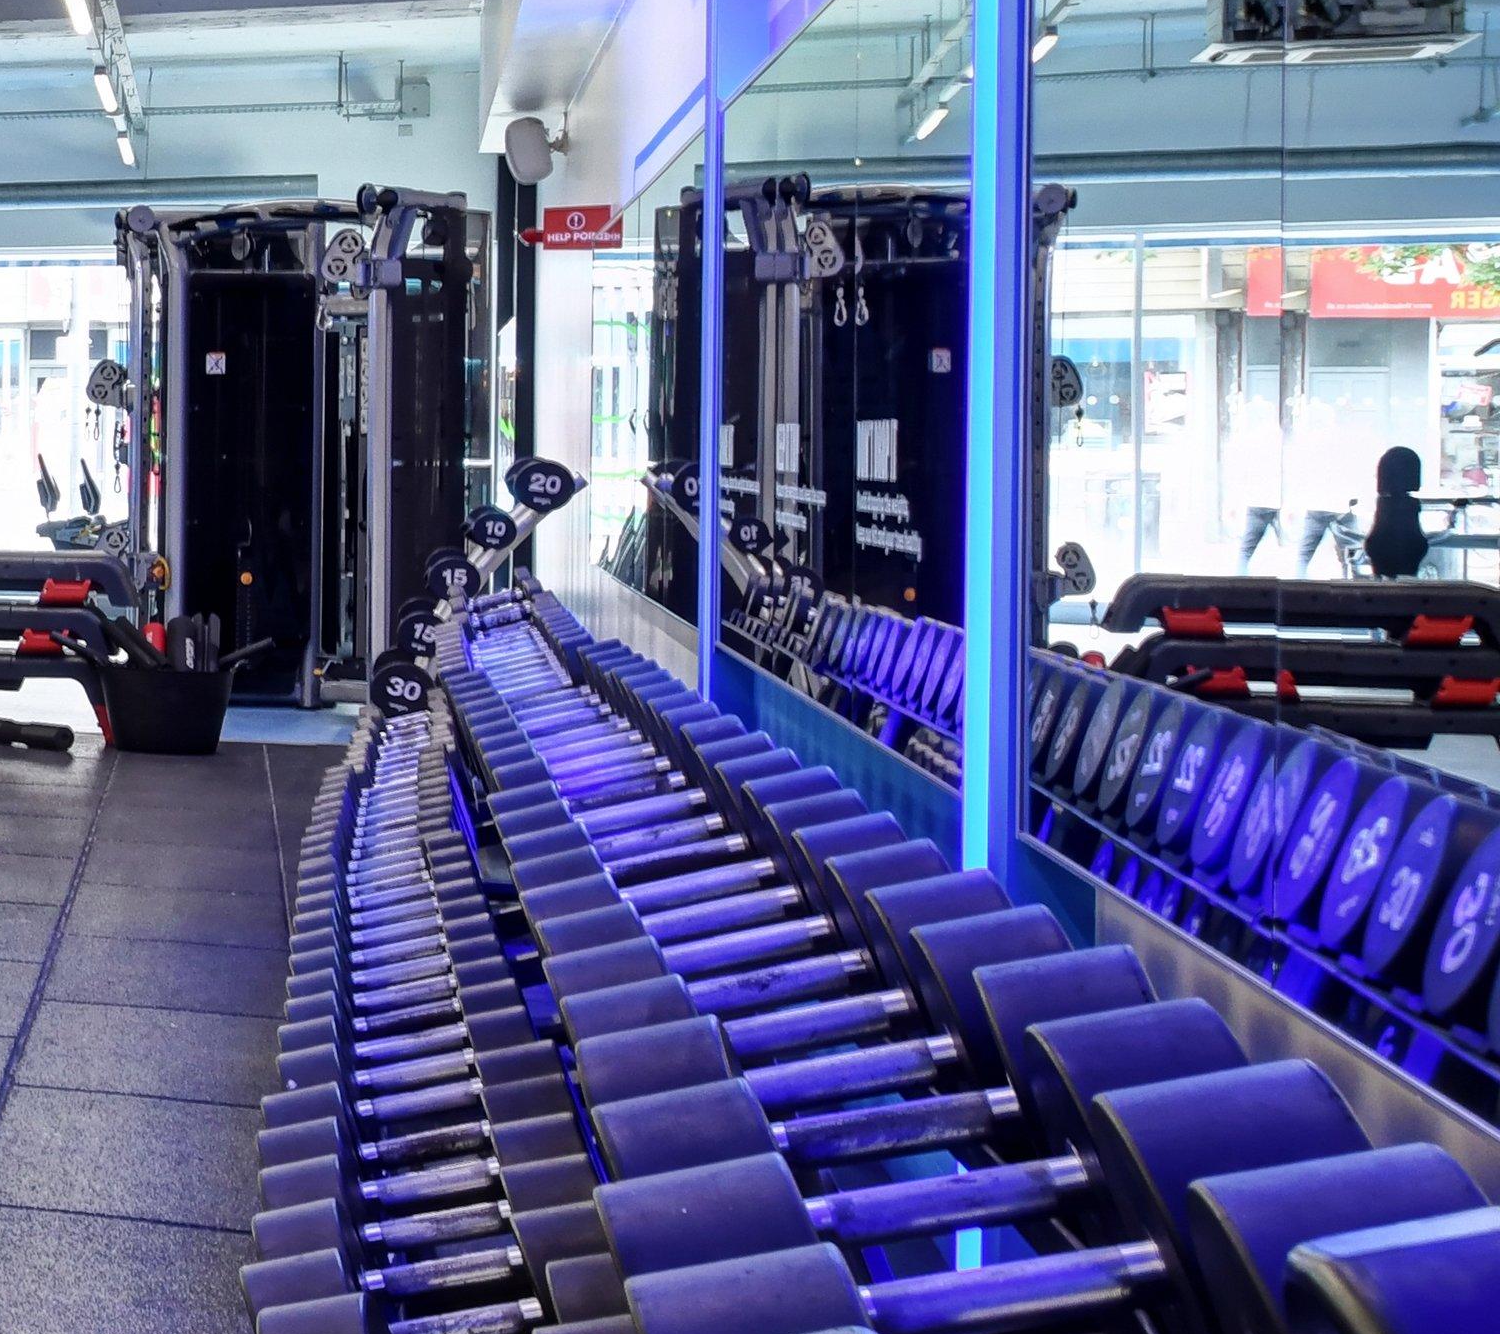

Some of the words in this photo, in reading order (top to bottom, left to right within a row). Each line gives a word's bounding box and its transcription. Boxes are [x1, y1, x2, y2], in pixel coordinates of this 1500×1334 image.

[547, 233, 571, 243] HELP
[528, 472, 562, 494] 20
[485, 520, 507, 537] 10
[442, 568, 468, 587] 15
[413, 622, 436, 643] 15
[385, 676, 422, 702] 30
